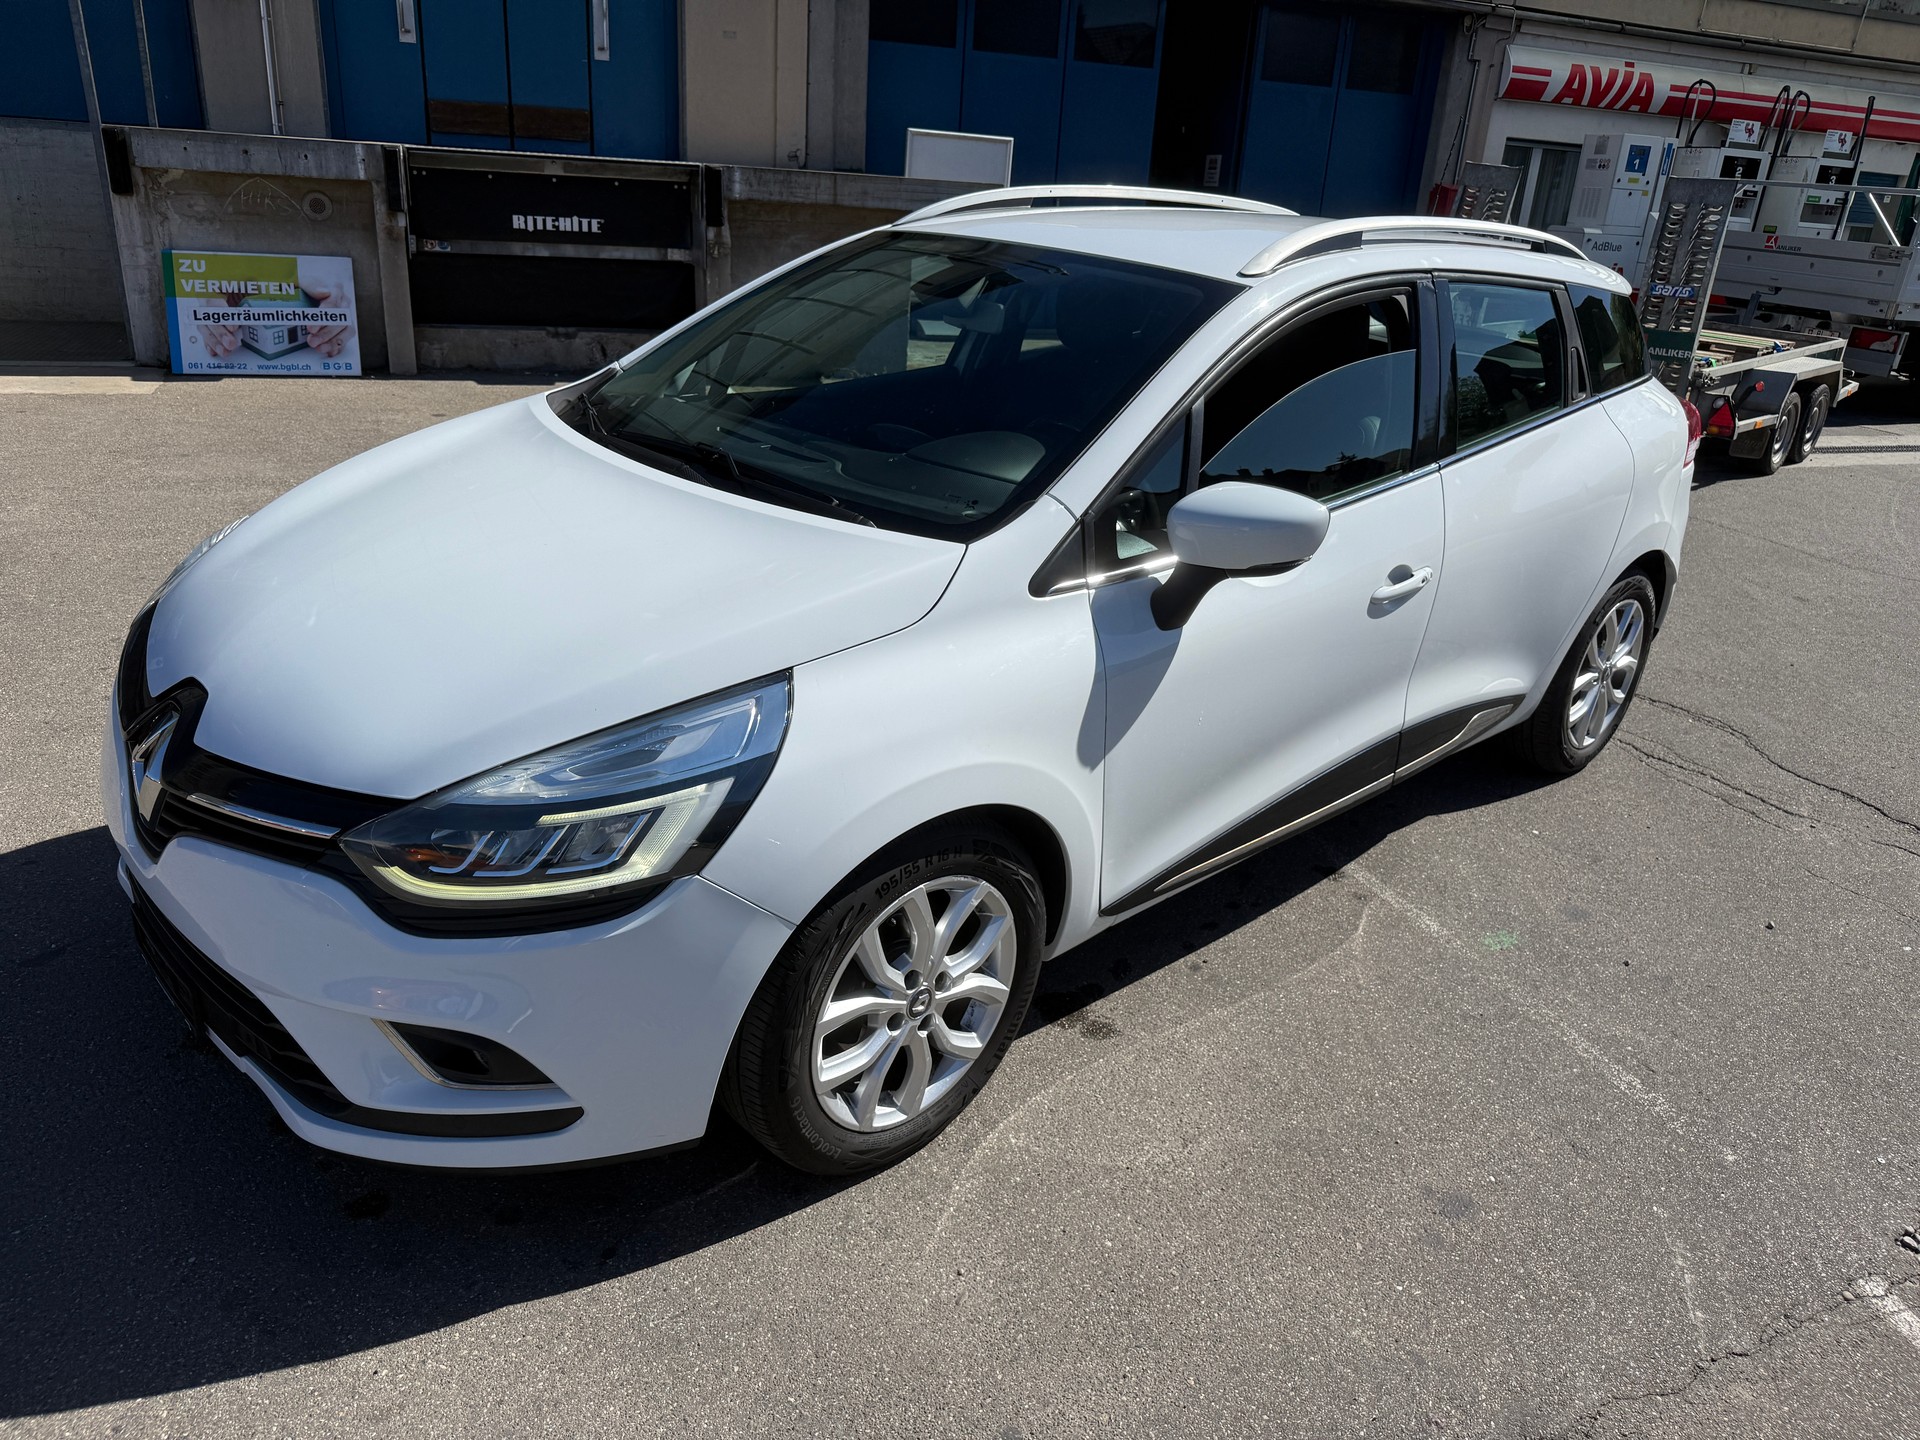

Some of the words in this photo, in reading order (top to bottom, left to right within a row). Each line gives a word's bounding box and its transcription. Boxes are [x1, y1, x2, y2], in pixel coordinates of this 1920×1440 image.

[1551, 61, 1655, 113] AVIA
[1633, 159, 1640, 170] 1
[1735, 166, 1743, 177] 2
[1829, 175, 1836, 185] 3
[1591, 241, 1622, 252] AdBlue
[178, 259, 206, 273] ZU
[180, 279, 296, 296] VERMIETEN
[193, 309, 347, 324] Lagerräumlichkeiten
[1648, 346, 1692, 359] ANLIKER
[875, 860, 920, 899] 195/55
[925, 855, 934, 868] R
[936, 848, 950, 863] 16
